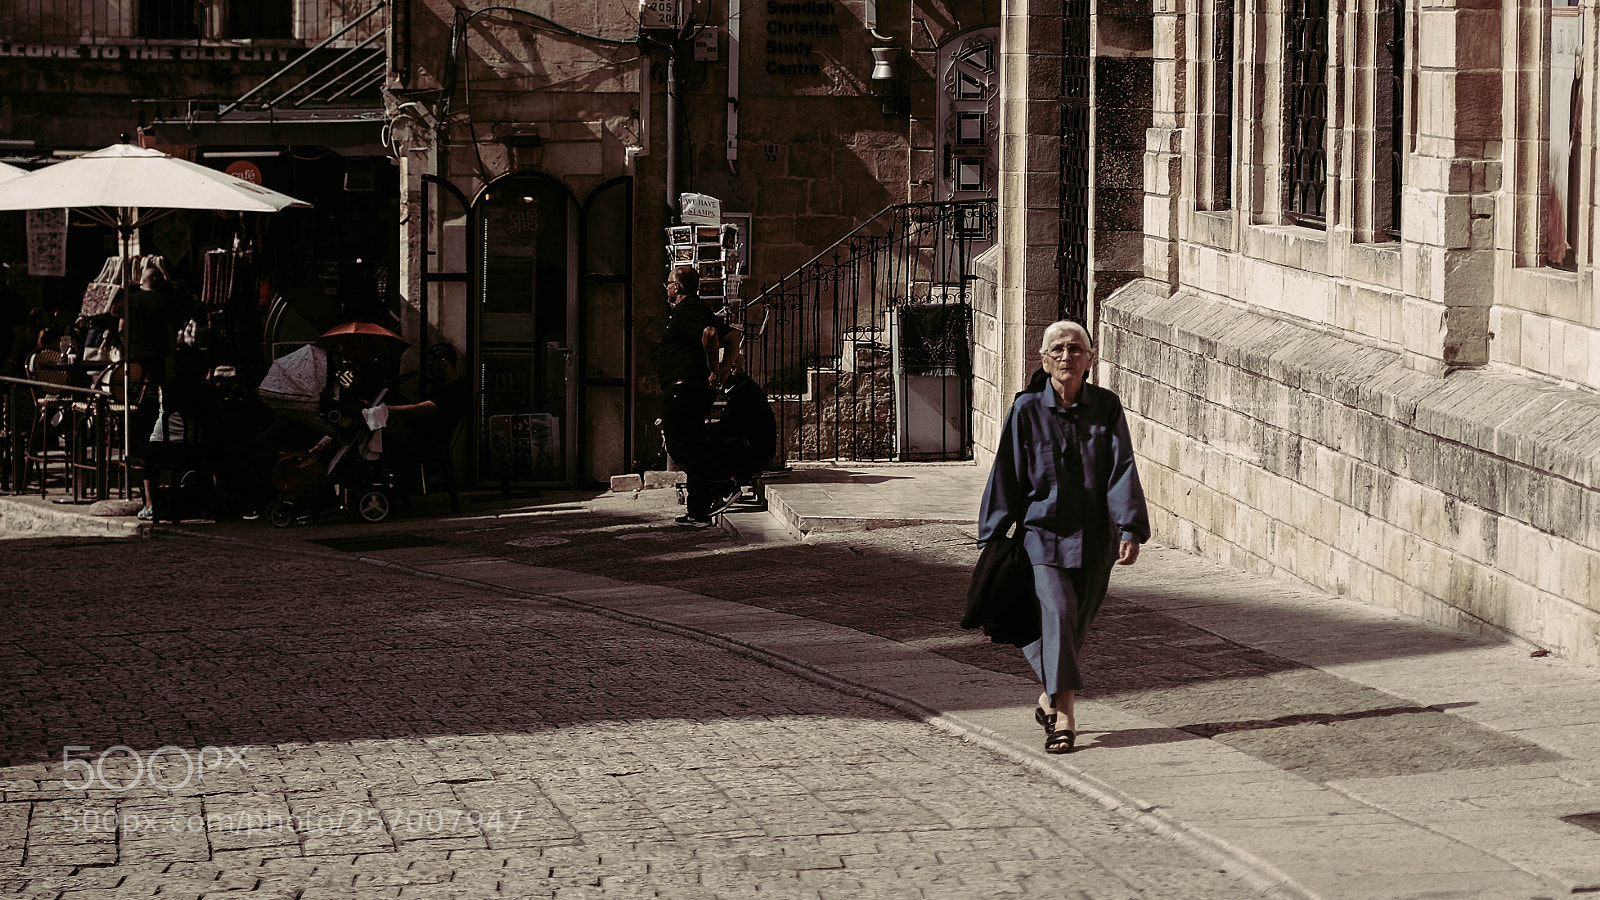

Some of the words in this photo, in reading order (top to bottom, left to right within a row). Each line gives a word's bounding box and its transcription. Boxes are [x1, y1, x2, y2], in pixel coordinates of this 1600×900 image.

[652, 2, 672, 12] 205
[766, 0, 835, 15] Swedish
[766, 20, 839, 35] Christian
[88, 46, 120, 60] TO
[127, 46, 173, 60] THE
[180, 47, 231, 60] OLD
[238, 47, 288, 61] CITY
[766, 40, 812, 57] Study
[766, 60, 820, 75] Centre
[698, 199, 716, 208] HAVE
[688, 208, 715, 217] STAMPS
